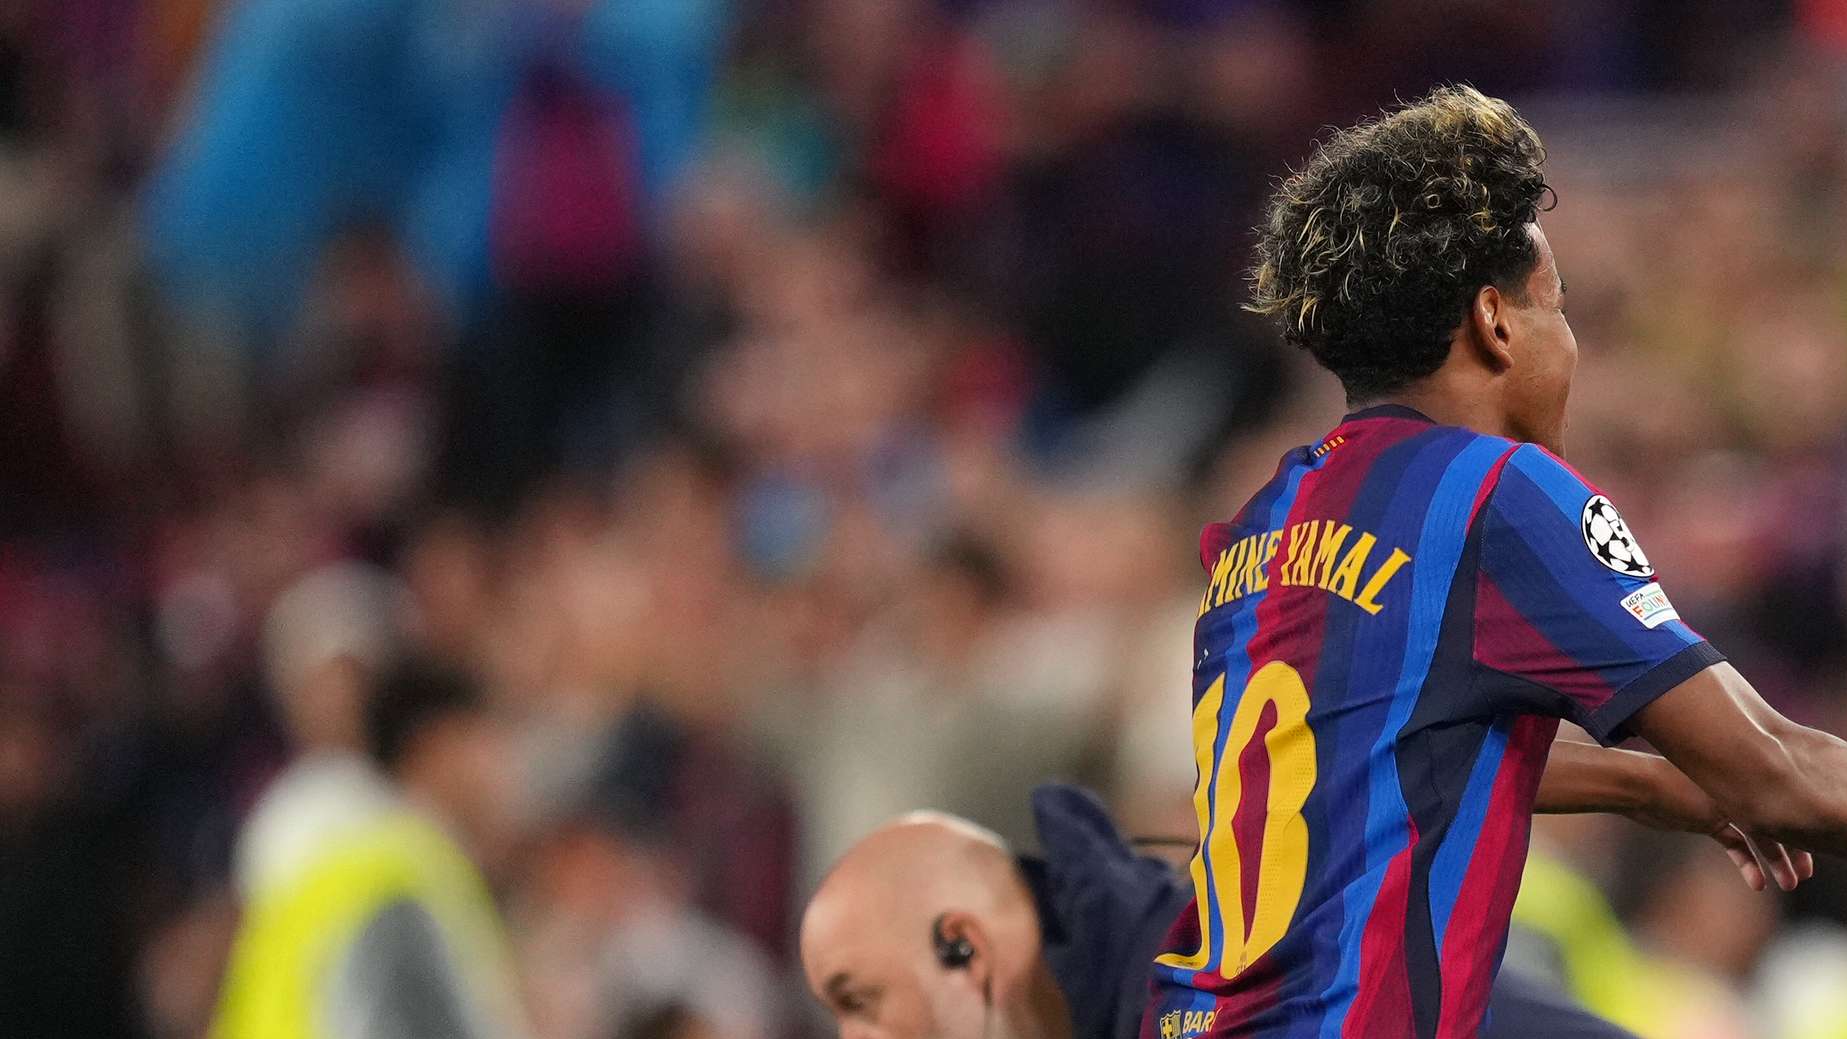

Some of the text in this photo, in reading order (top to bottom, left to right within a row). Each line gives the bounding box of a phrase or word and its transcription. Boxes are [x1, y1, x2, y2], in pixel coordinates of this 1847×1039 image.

[1199, 519, 1412, 618] MINE YAMAL
[1626, 593, 1646, 607] UEFA
[1154, 661, 1318, 980] 10
[1182, 1006, 1223, 1034] BAR
